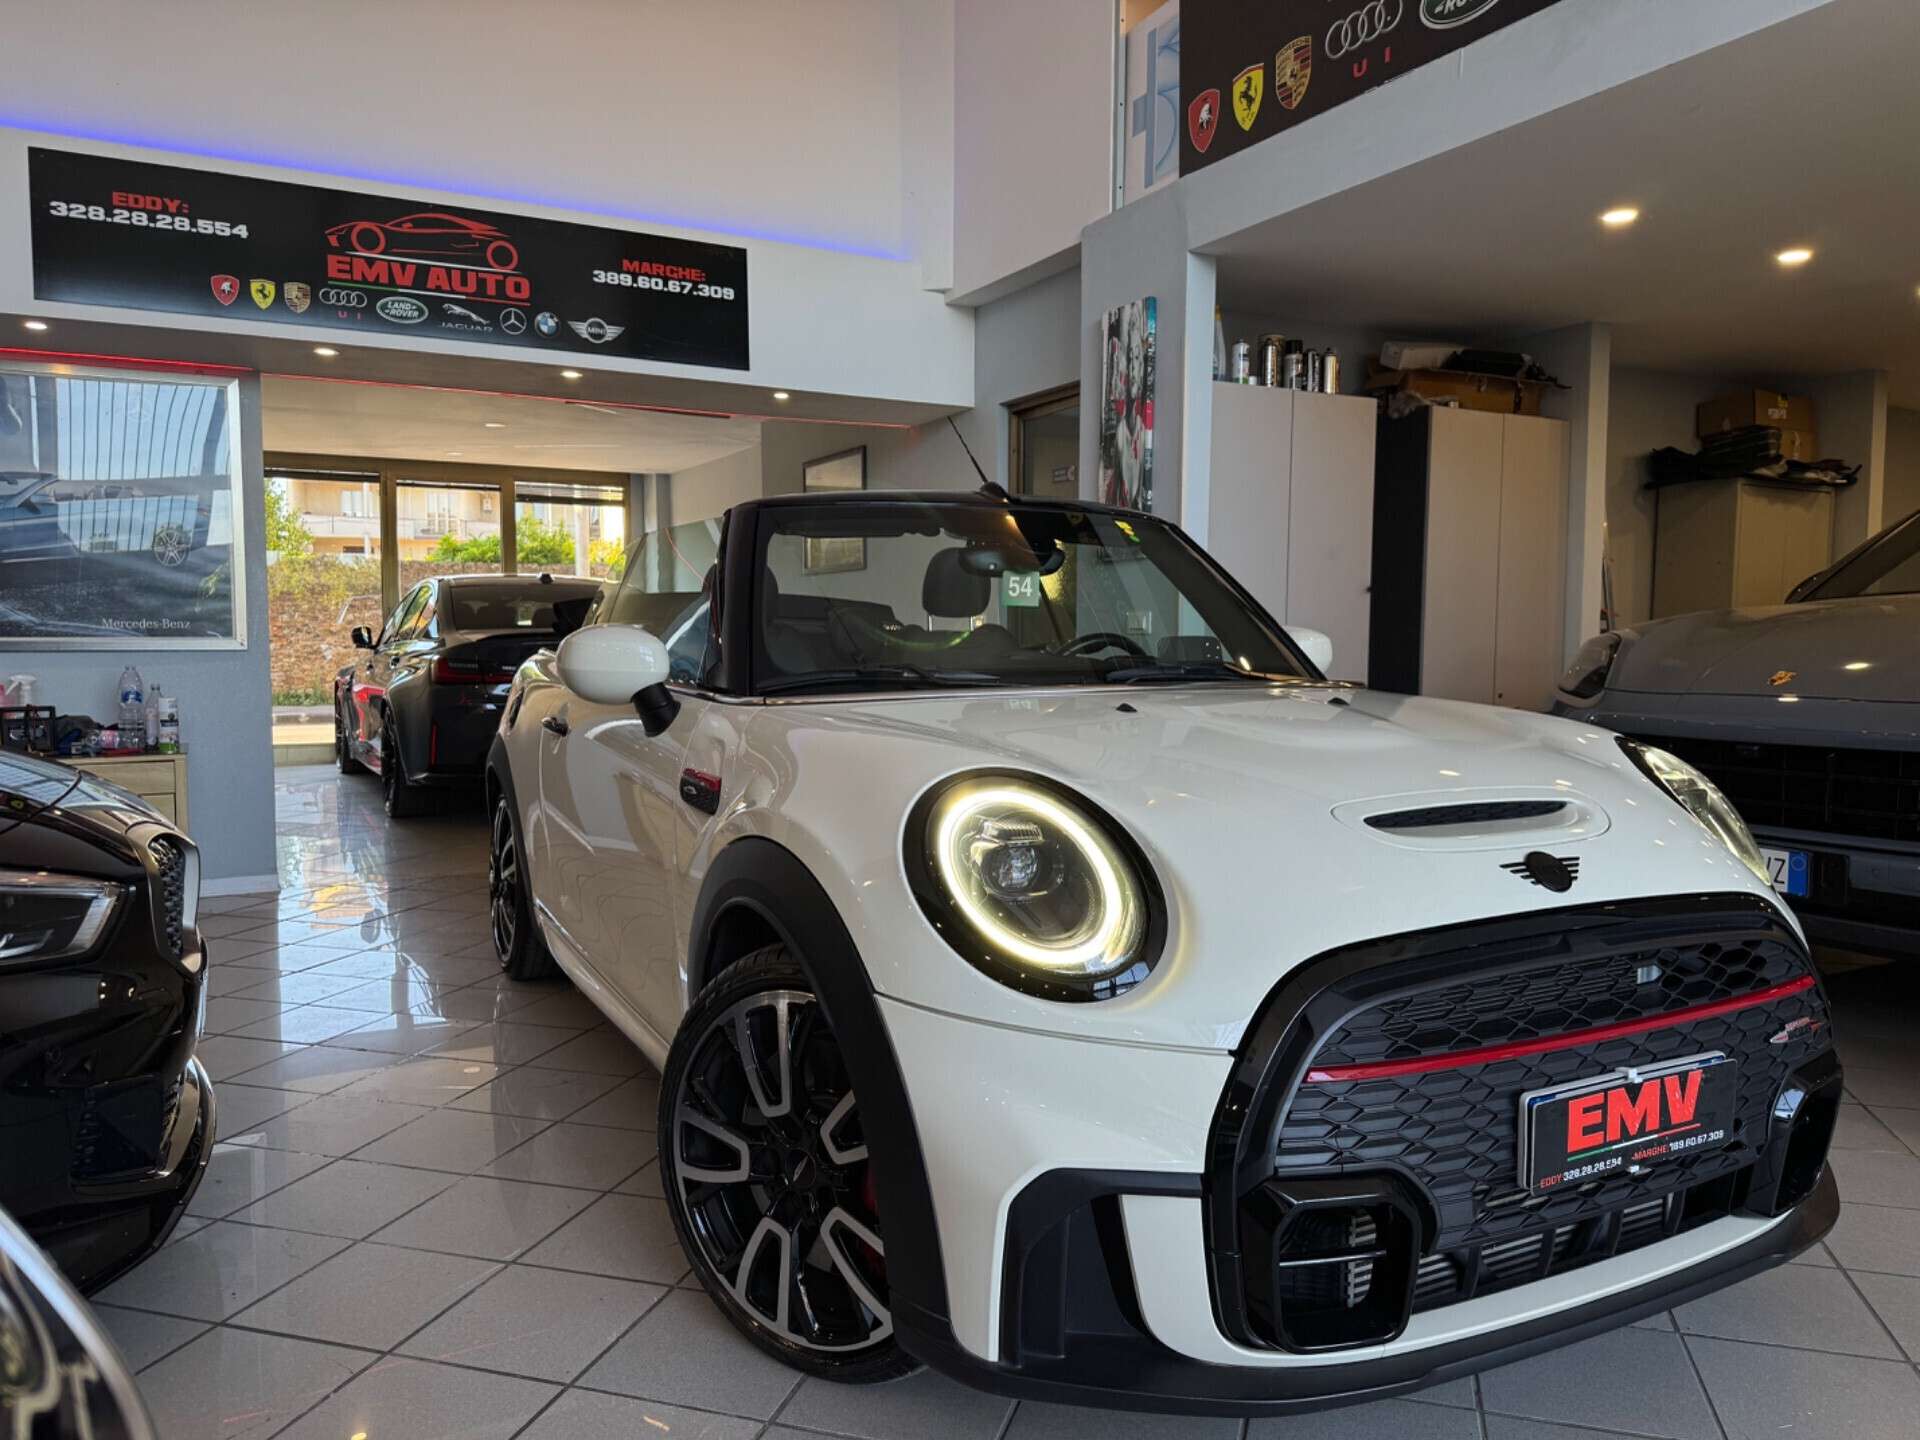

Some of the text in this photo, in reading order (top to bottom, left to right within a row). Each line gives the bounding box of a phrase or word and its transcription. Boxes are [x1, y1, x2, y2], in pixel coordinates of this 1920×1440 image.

[112, 191, 189, 214] EDDY:
[49, 201, 249, 239] 328.28.28.554
[327, 254, 530, 299] EMV AUTO
[592, 270, 735, 300] 389.60.67.309
[440, 321, 493, 333] JAGUAR
[1008, 576, 1033, 597] 54
[102, 618, 191, 630] Mercedes-Benz
[1567, 1069, 1703, 1153] EMV
